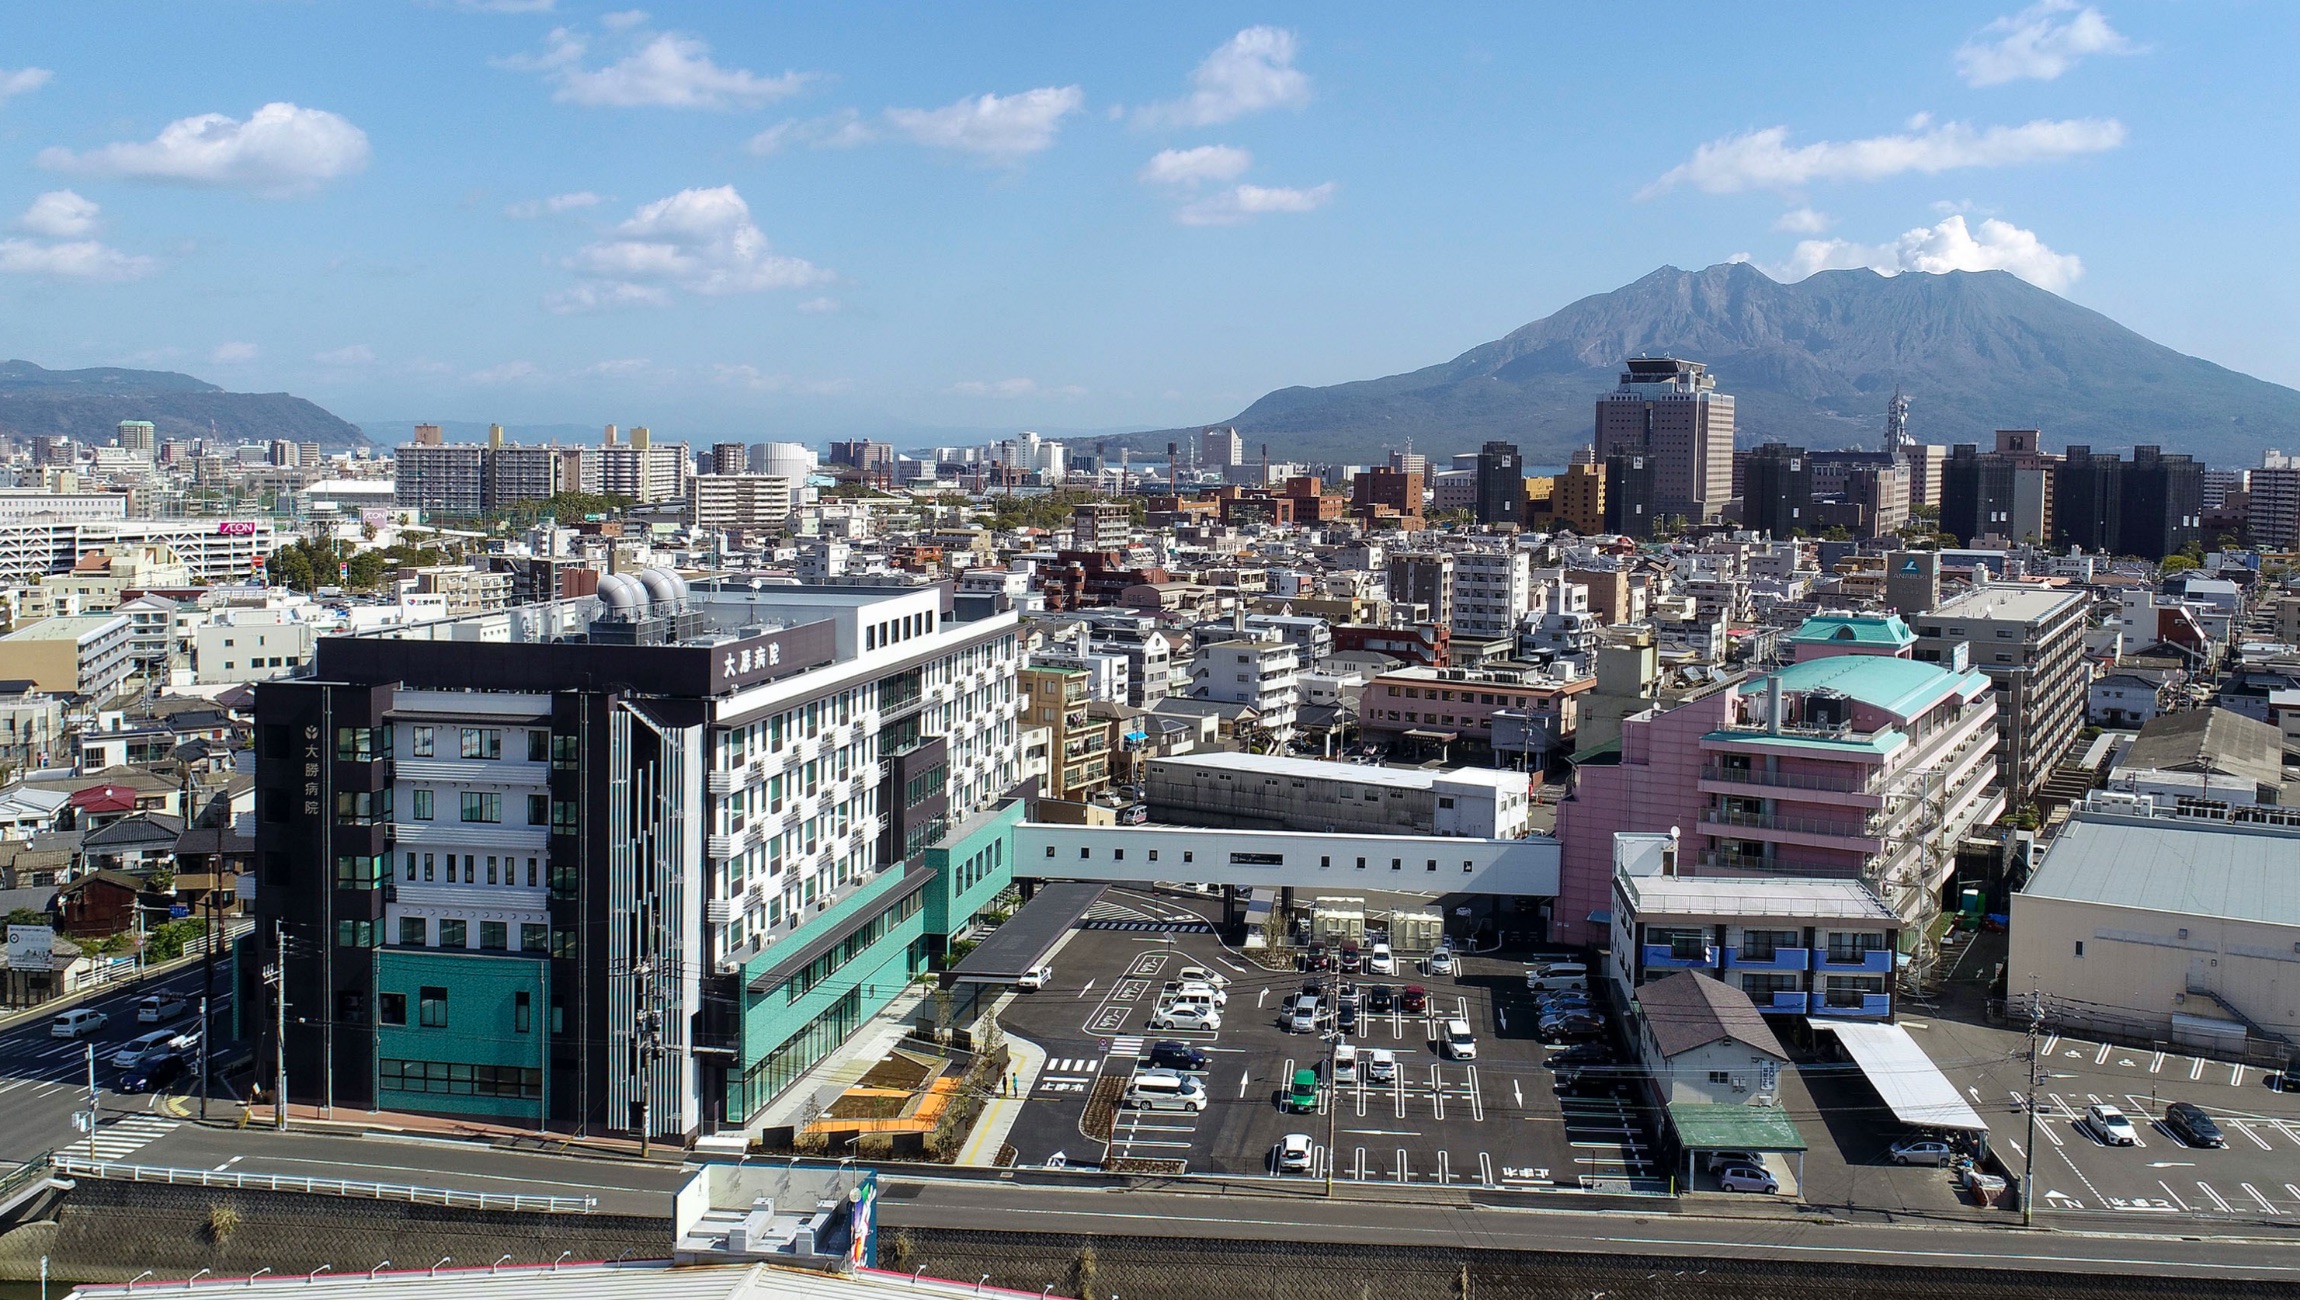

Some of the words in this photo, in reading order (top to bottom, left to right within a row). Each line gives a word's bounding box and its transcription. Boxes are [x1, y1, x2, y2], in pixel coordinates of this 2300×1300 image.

[304, 743, 320, 815] 大勝病院
[1039, 1082, 1085, 1092] 止まれ
[1502, 1167, 1550, 1179] 止まれ
[2046, 1197, 2086, 1210] IN
